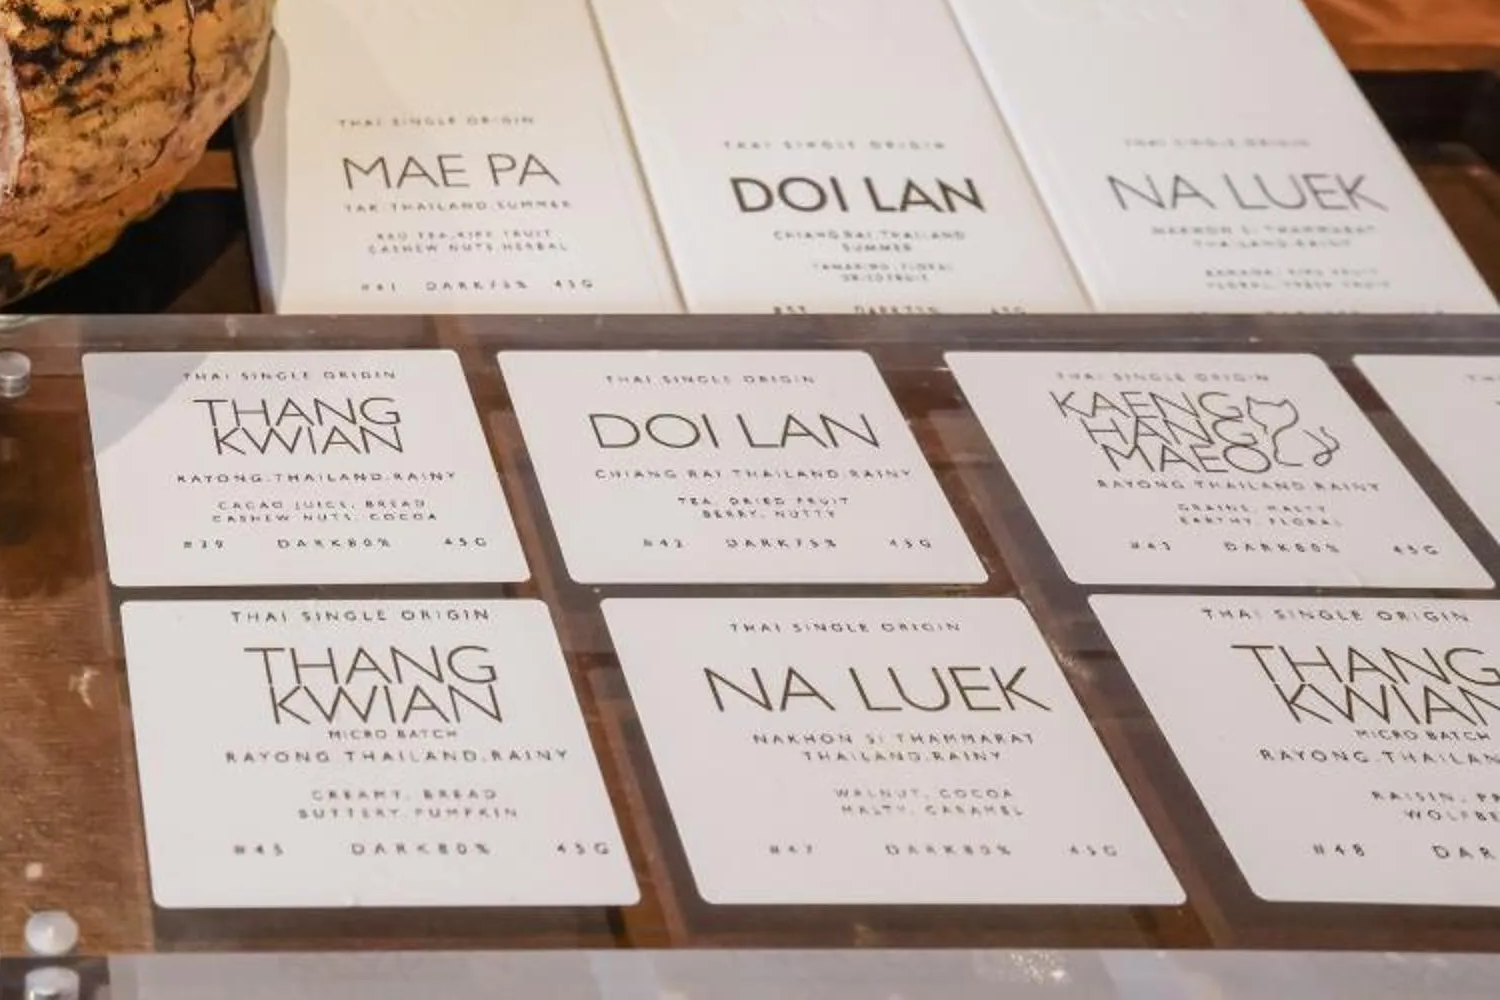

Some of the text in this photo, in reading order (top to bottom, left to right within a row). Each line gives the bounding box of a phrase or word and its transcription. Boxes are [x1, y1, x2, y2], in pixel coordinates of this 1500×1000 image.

[342, 153, 561, 190] MAE PA
[729, 176, 987, 213] DOI LAN
[1106, 172, 1389, 211] NA LUEK
[193, 397, 402, 427] THANG
[1049, 390, 1245, 420] KAENG
[213, 425, 404, 455] KWIAN
[588, 412, 881, 449] DOI LAN
[1079, 417, 1260, 446] HANG
[1100, 443, 1272, 474] MAEO
[231, 608, 491, 623] THAI SINGLE ORIGIN
[729, 622, 962, 634] THAI SINGLE ORIGIN
[243, 645, 497, 685] THANG
[1230, 644, 1500, 687] THANG
[703, 666, 1053, 712] NA LUEK
[269, 684, 504, 725] KWIAN
[328, 728, 459, 741] MICRO BATCH
[752, 732, 854, 745] NAKHON
[490, 748, 569, 762] RAINY
[931, 750, 1002, 762] RAINY
[350, 841, 491, 857] DARK80%
